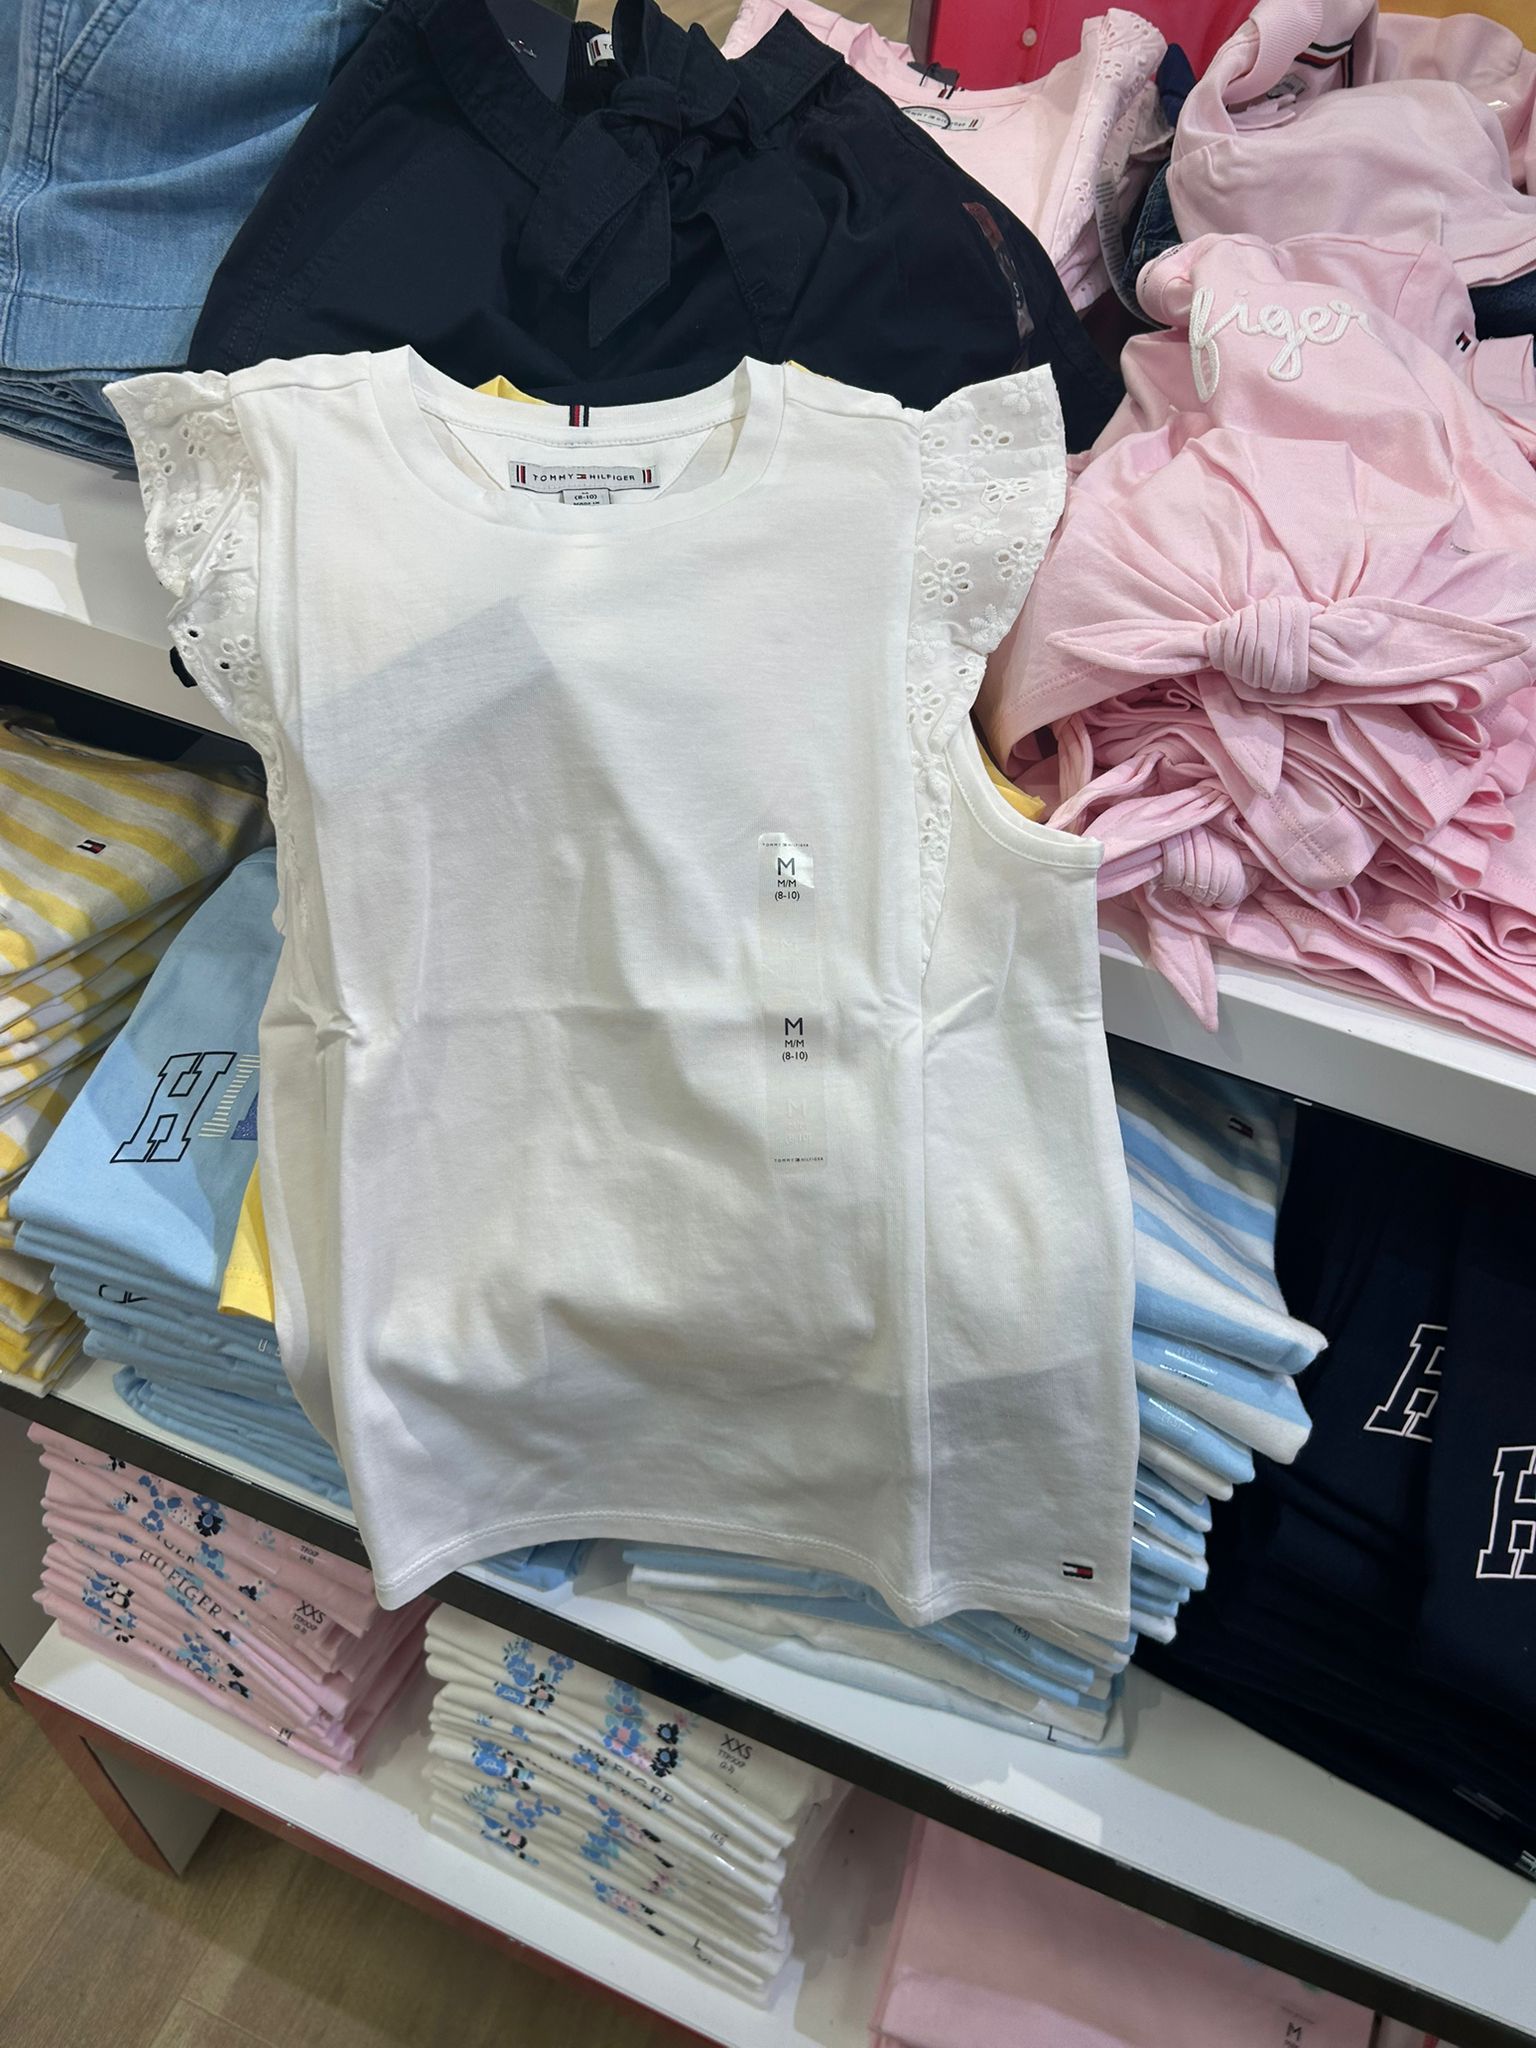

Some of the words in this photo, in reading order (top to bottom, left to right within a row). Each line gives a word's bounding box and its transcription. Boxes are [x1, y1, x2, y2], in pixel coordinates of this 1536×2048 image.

[532, 473, 574, 482] TOMMY
[589, 474, 636, 482] HILFIGER
[777, 857, 796, 876] M
[777, 879, 798, 888] M/M
[774, 891, 801, 902] (8-10)
[784, 1017, 804, 1036] M
[784, 1039, 805, 1048] M/M
[781, 1051, 809, 1063] (8-10)
[140, 1550, 222, 1618] HILFIGER
[296, 1600, 327, 1625] XXS
[1047, 1725, 1057, 1742] L
[720, 1733, 753, 1760] XXS
[1285, 2021, 1303, 2041] M
